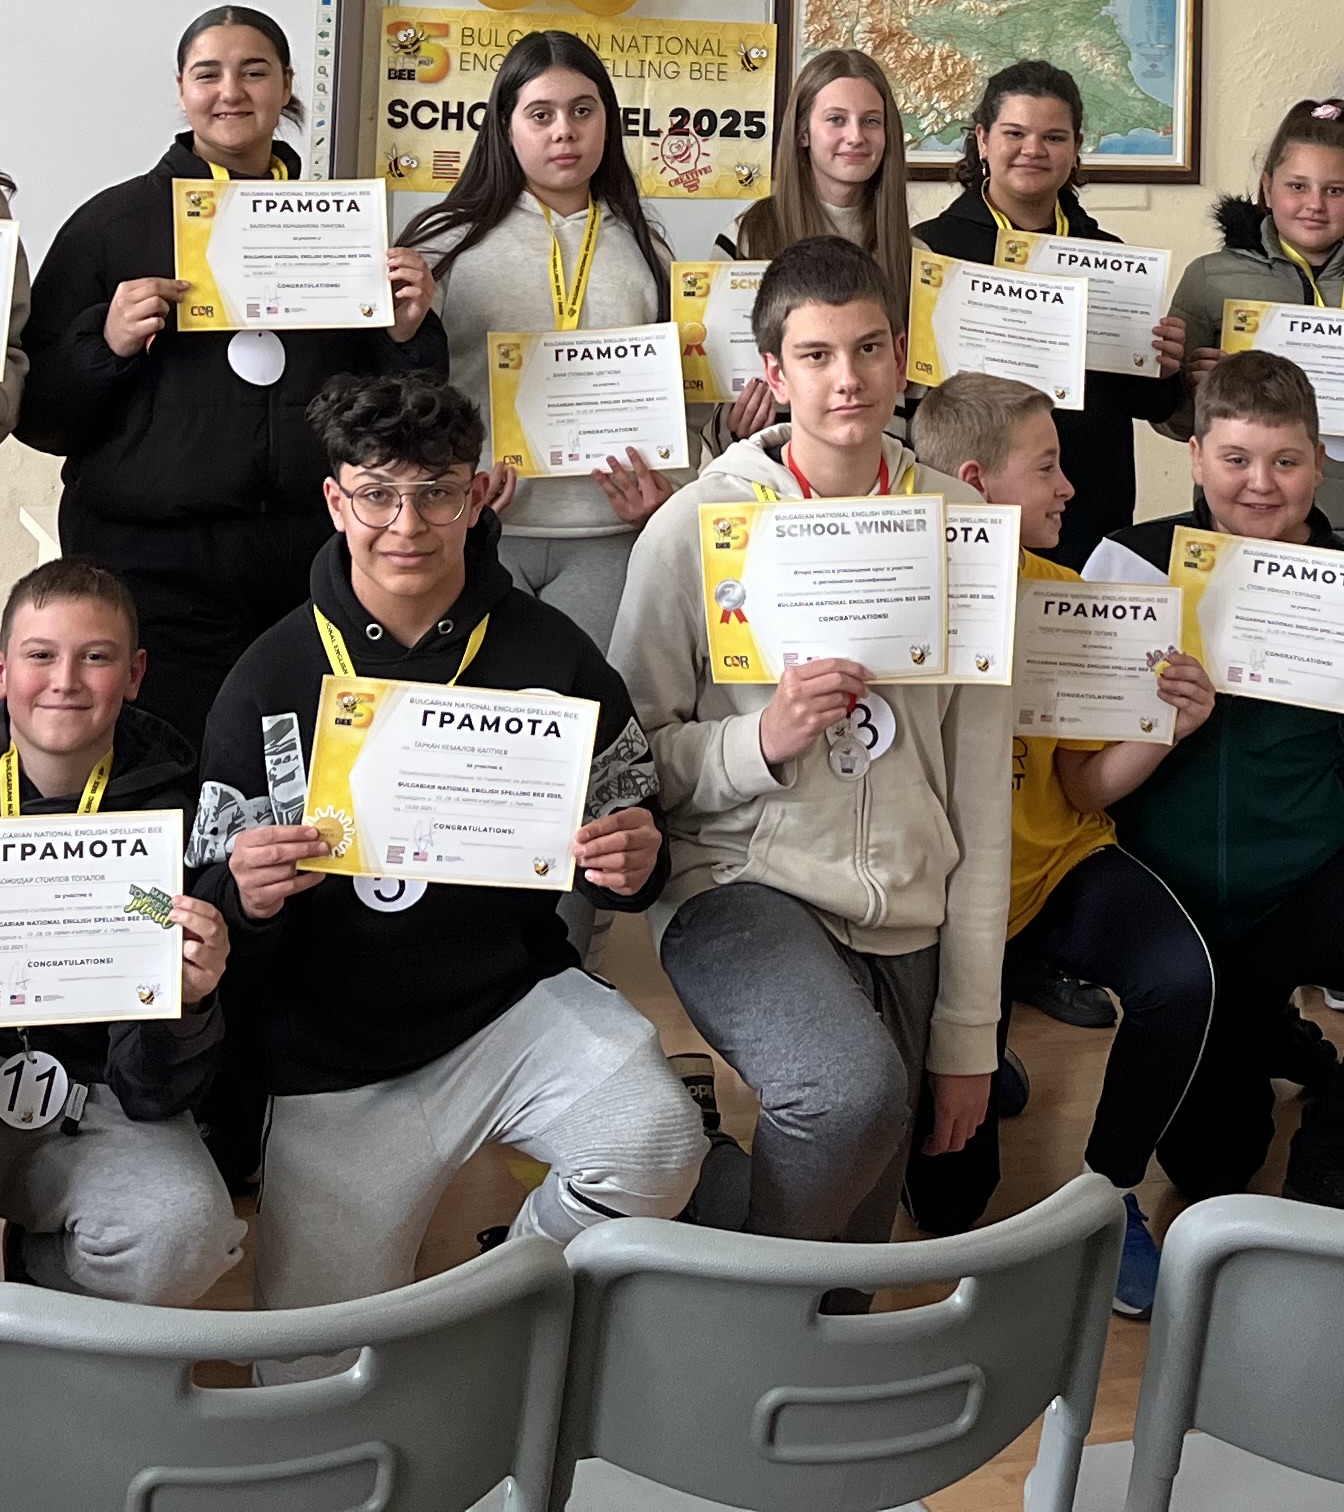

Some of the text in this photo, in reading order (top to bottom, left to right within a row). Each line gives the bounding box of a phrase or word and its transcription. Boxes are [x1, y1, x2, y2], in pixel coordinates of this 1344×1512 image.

[611, 35, 728, 57] NATIONAL
[388, 68, 415, 81] BEE
[689, 61, 728, 81] BEE
[387, 99, 489, 132] SCHO
[668, 107, 766, 139] 2025
[252, 199, 360, 213] ГРАМОТА
[1057, 253, 1148, 275] ГРАМОТА
[971, 280, 1064, 305] ГРАМОТА
[555, 343, 657, 362] ГРАМОТА
[775, 518, 927, 538] SCHOOL WINNER
[1043, 601, 1158, 621] ГРАМОТА
[421, 710, 562, 739] ГРАМОТА
[34, 830, 72, 838] NATIONAL
[74, 829, 108, 837] ENGLISH
[110, 827, 146, 836] SPELLING
[147, 826, 163, 834] BEE
[2, 838, 148, 862] ГРАМОТА
[27, 957, 113, 968] CONGRATULATIONS!
[3, 1059, 58, 1117] 11
